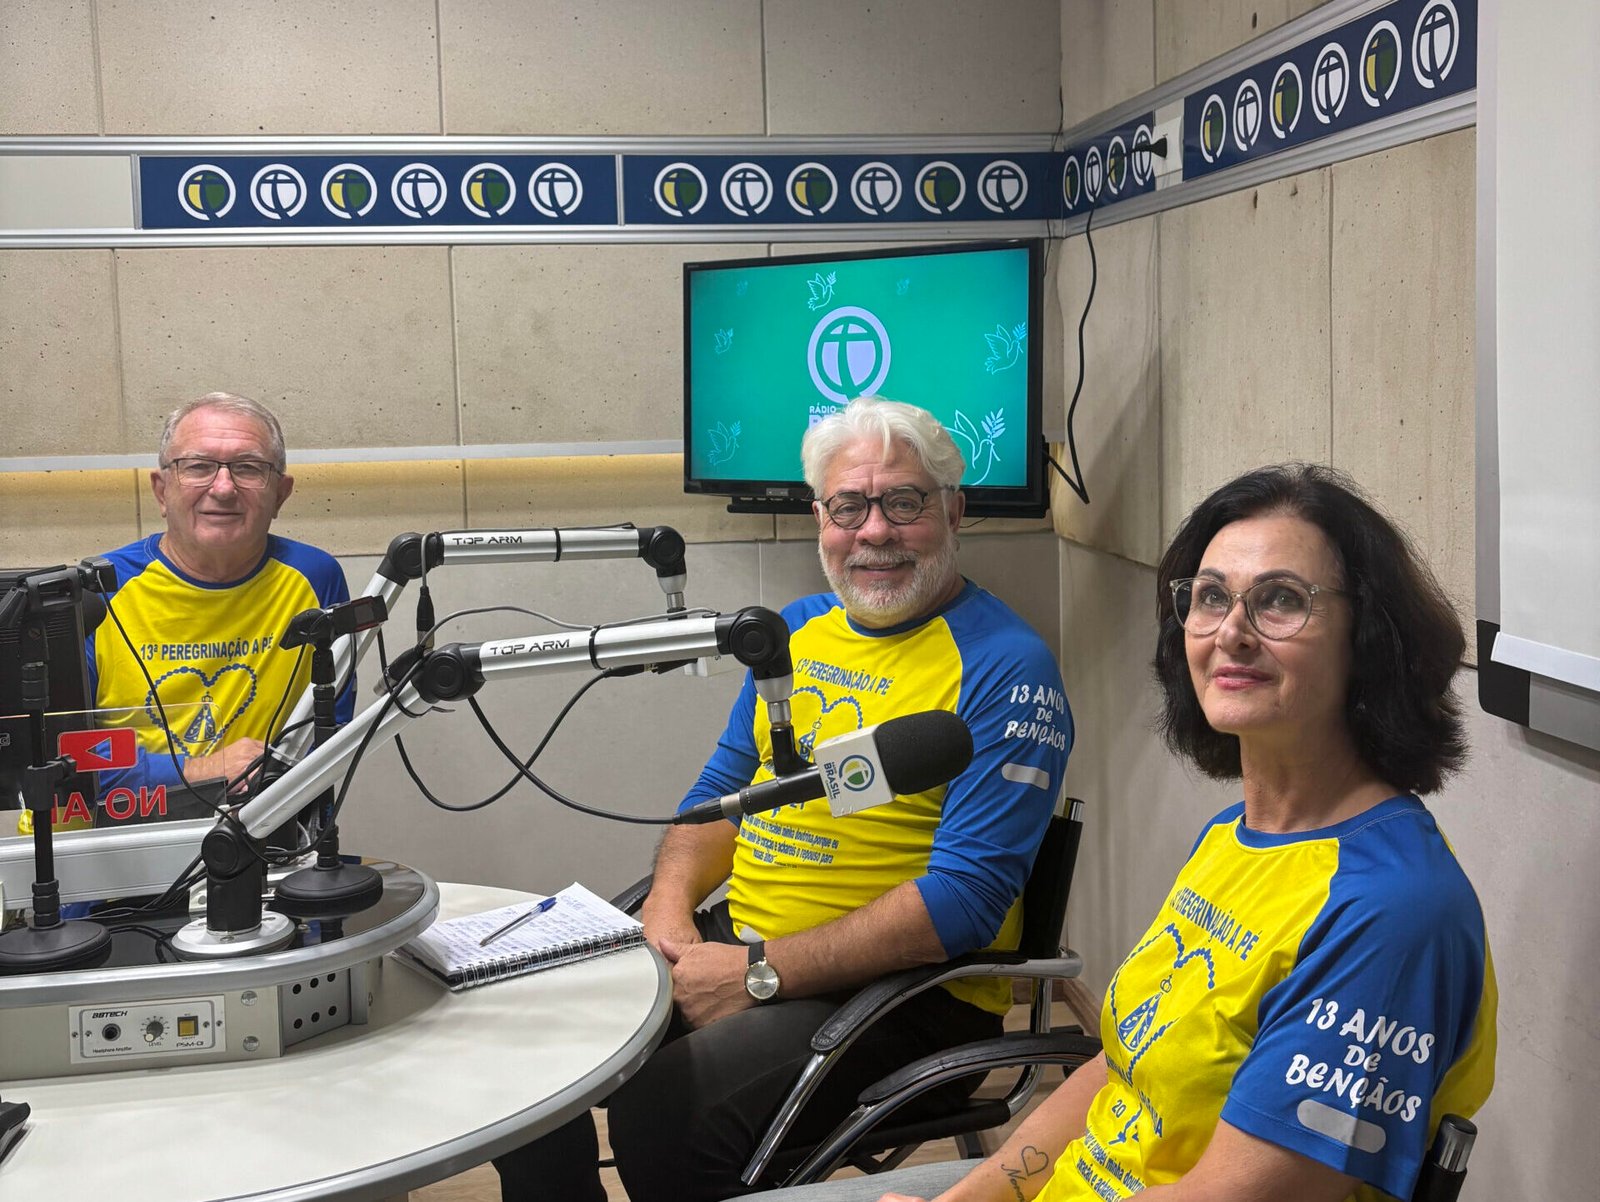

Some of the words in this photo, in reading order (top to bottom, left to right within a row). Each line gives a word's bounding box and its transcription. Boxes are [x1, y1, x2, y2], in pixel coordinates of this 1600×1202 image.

[809, 402, 837, 413] RÁDIO
[452, 536, 484, 545] TOP
[488, 535, 523, 544] ARM
[161, 637, 249, 661] PEREGRINAÇÃO
[251, 639, 259, 654] A
[490, 644, 525, 655] TOP
[529, 639, 570, 652] ARM
[805, 660, 871, 693] PEREGRINAÇÃO
[875, 675, 895, 695] PÉ
[1010, 684, 1030, 704] 13
[1032, 684, 1064, 715] ANOS
[824, 762, 840, 799] BRASIL
[1234, 930, 1262, 960] PÉ
[1306, 998, 1339, 1030] 13
[1339, 1008, 1435, 1064] ANOS
[1111, 1099, 1127, 1118] 20
